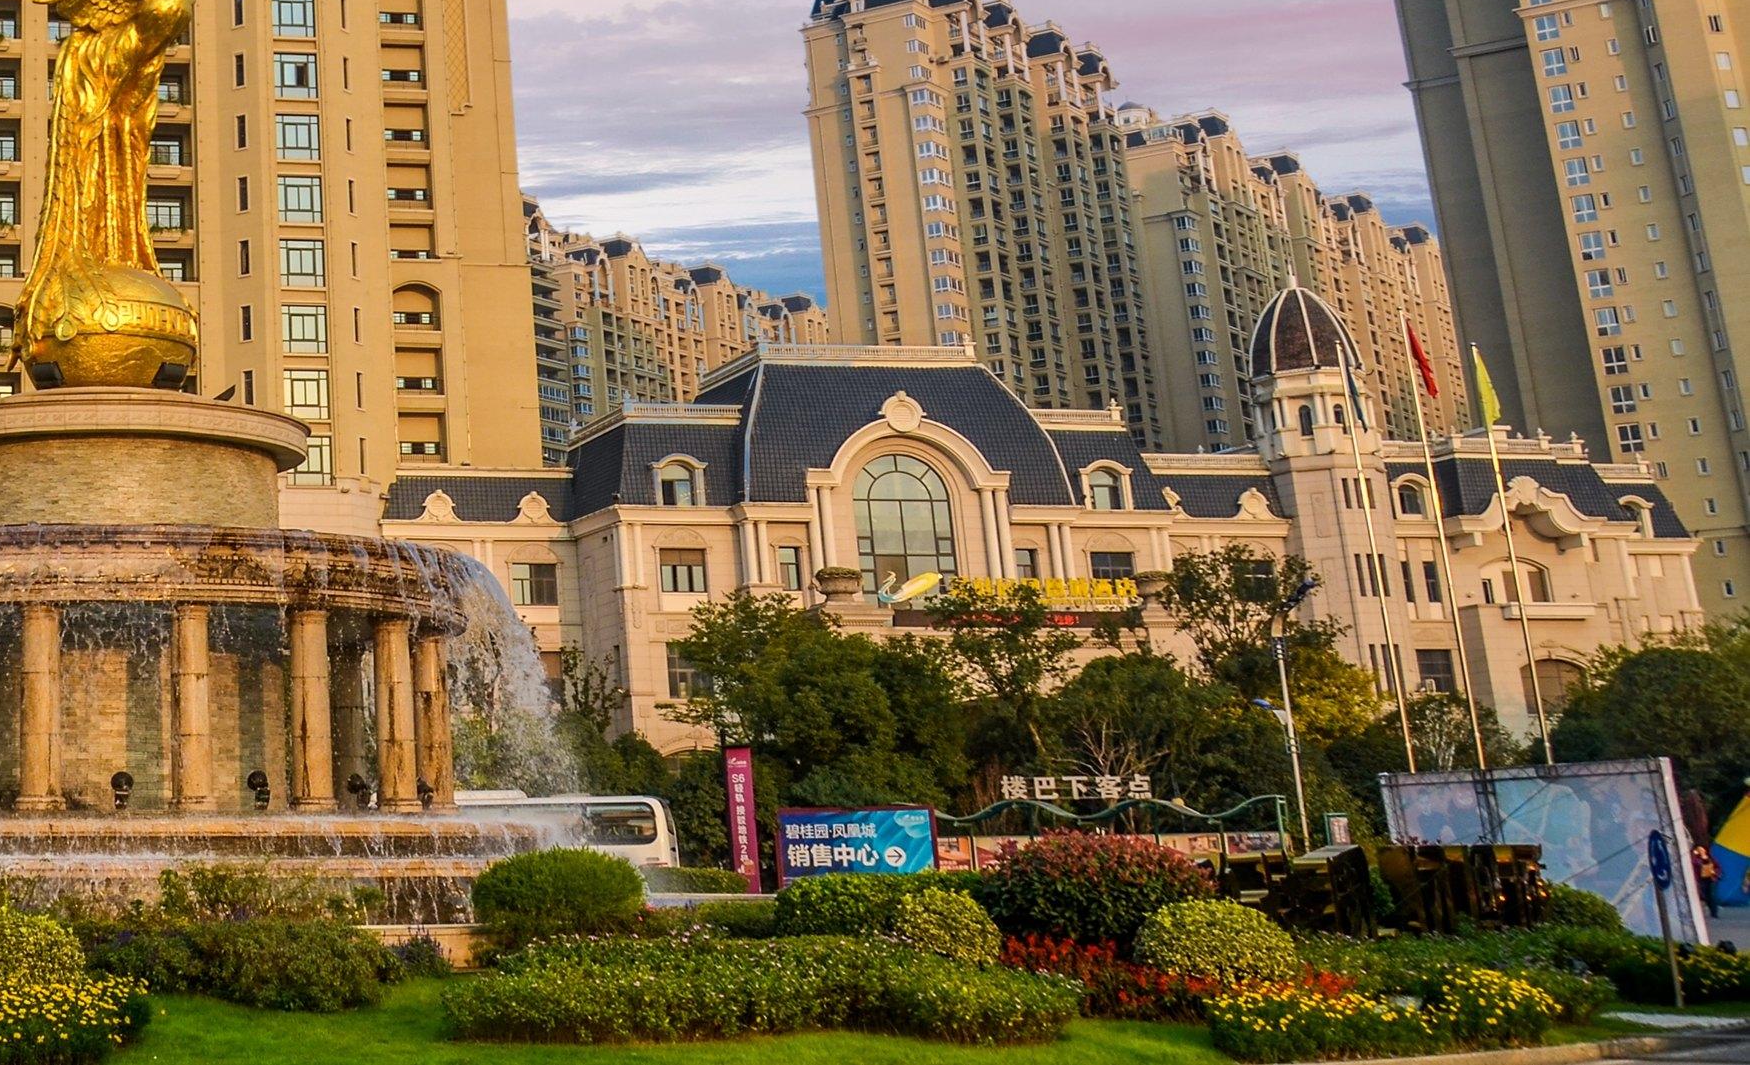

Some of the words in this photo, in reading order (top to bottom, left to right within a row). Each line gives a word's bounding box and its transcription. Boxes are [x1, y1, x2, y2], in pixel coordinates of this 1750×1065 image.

[1000, 774, 1152, 800] 楼巴下客点
[785, 822, 877, 840] 碧桂园·凤凰城
[787, 843, 879, 867] 销售中心
